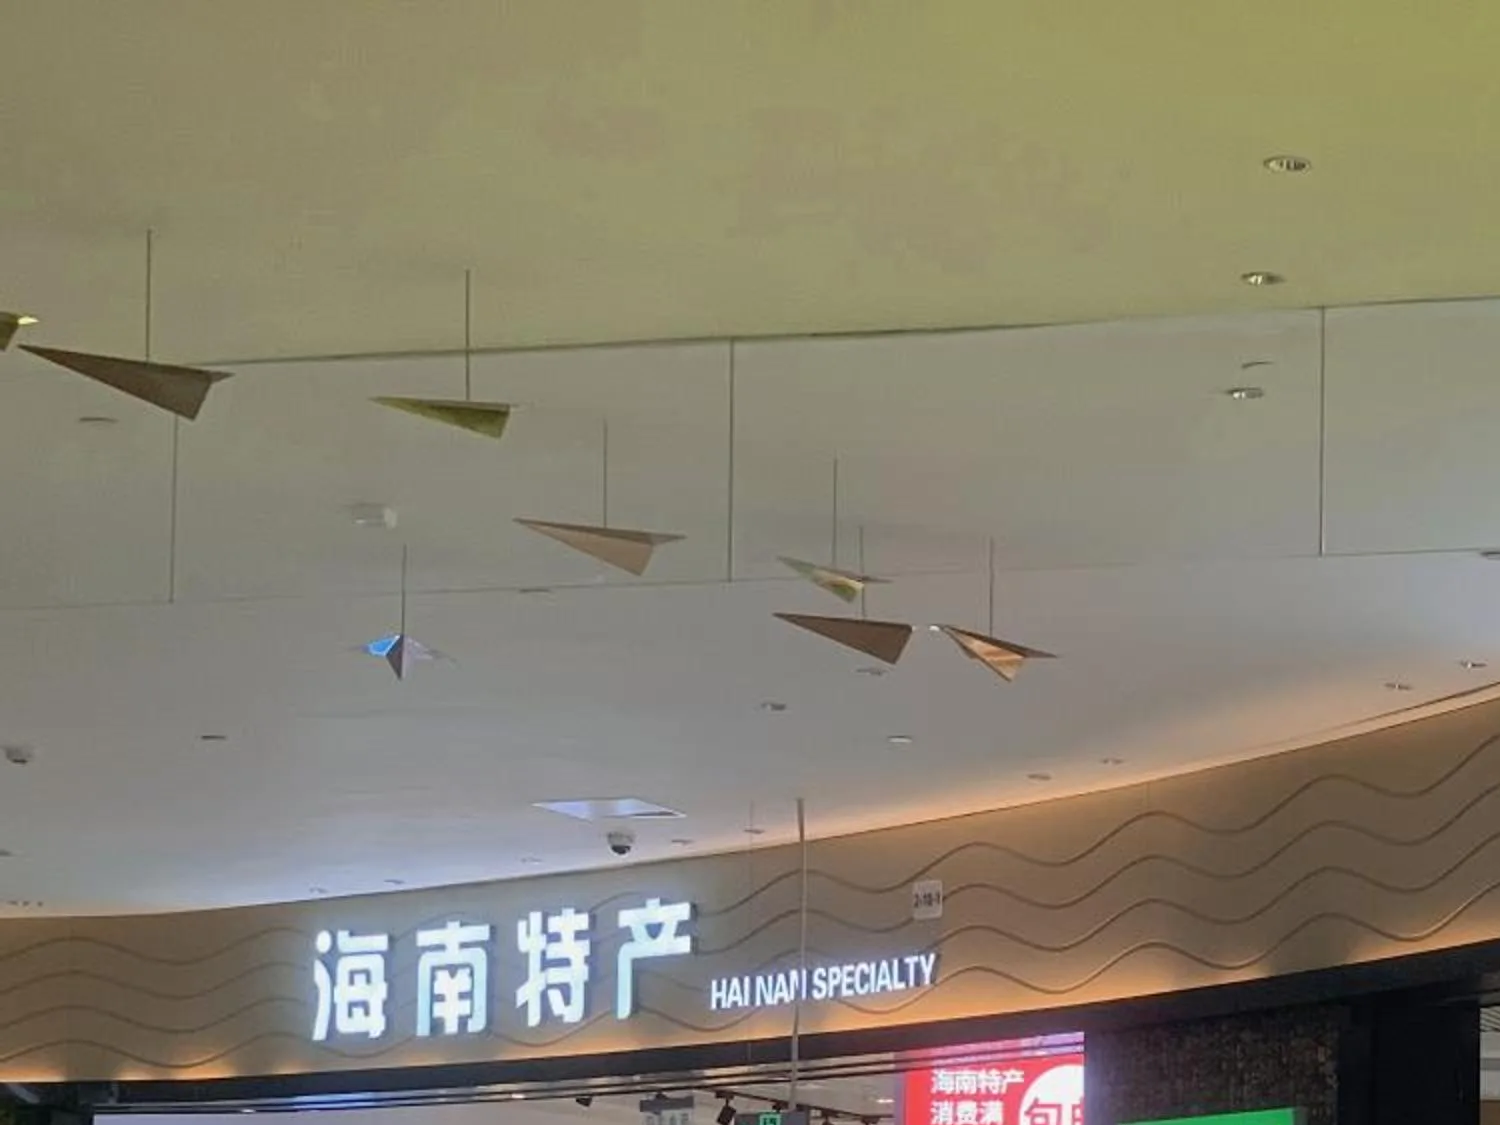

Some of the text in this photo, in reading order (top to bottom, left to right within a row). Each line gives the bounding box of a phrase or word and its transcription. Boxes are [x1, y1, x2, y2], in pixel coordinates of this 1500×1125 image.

[311, 896, 693, 1042] 海南特产
[710, 953, 936, 1010] HAI NAN SPECIALTY
[930, 1068, 1025, 1095] 海南特产
